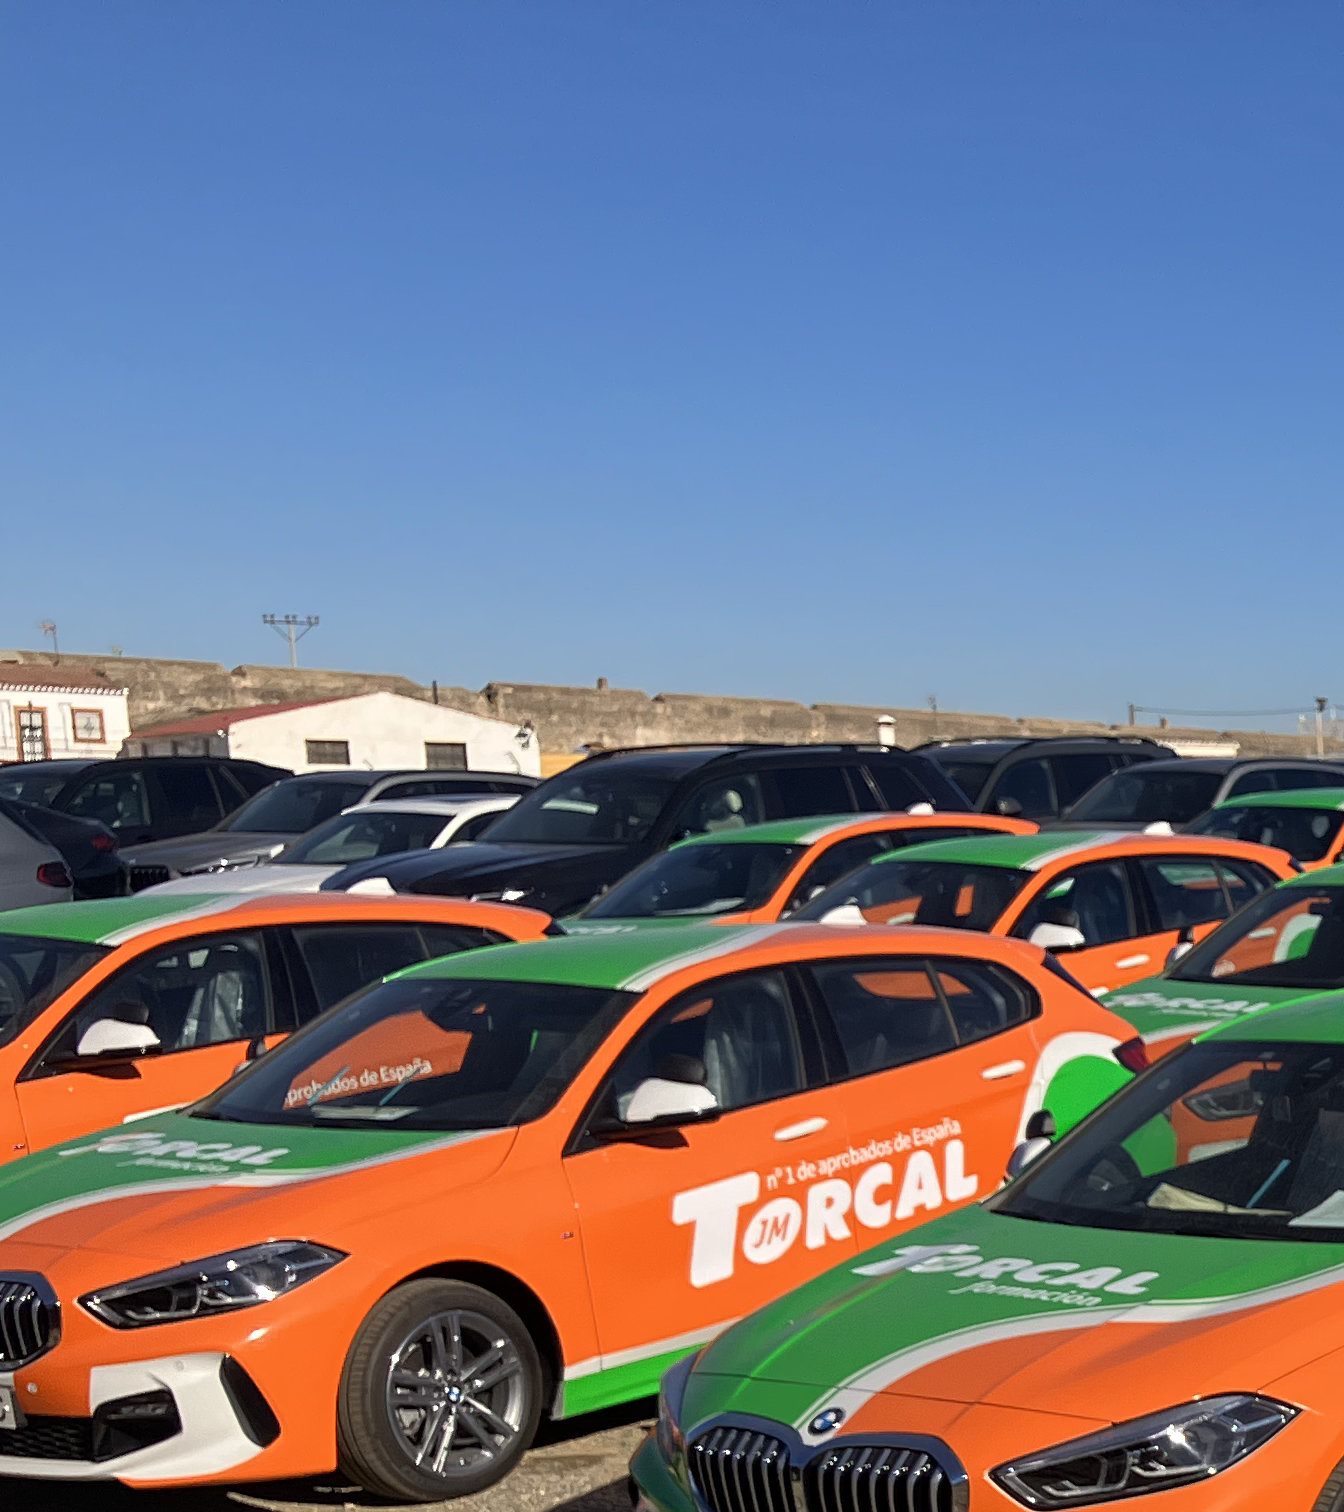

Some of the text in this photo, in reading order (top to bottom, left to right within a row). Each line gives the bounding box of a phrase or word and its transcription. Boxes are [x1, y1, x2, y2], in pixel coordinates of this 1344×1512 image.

[797, 1160, 817, 1181] de
[818, 1140, 893, 1177] aprobados
[894, 1131, 912, 1151] de
[912, 1117, 961, 1147] España
[672, 1139, 978, 1289] TORCAL
[851, 1244, 1160, 1295] TORCAL
